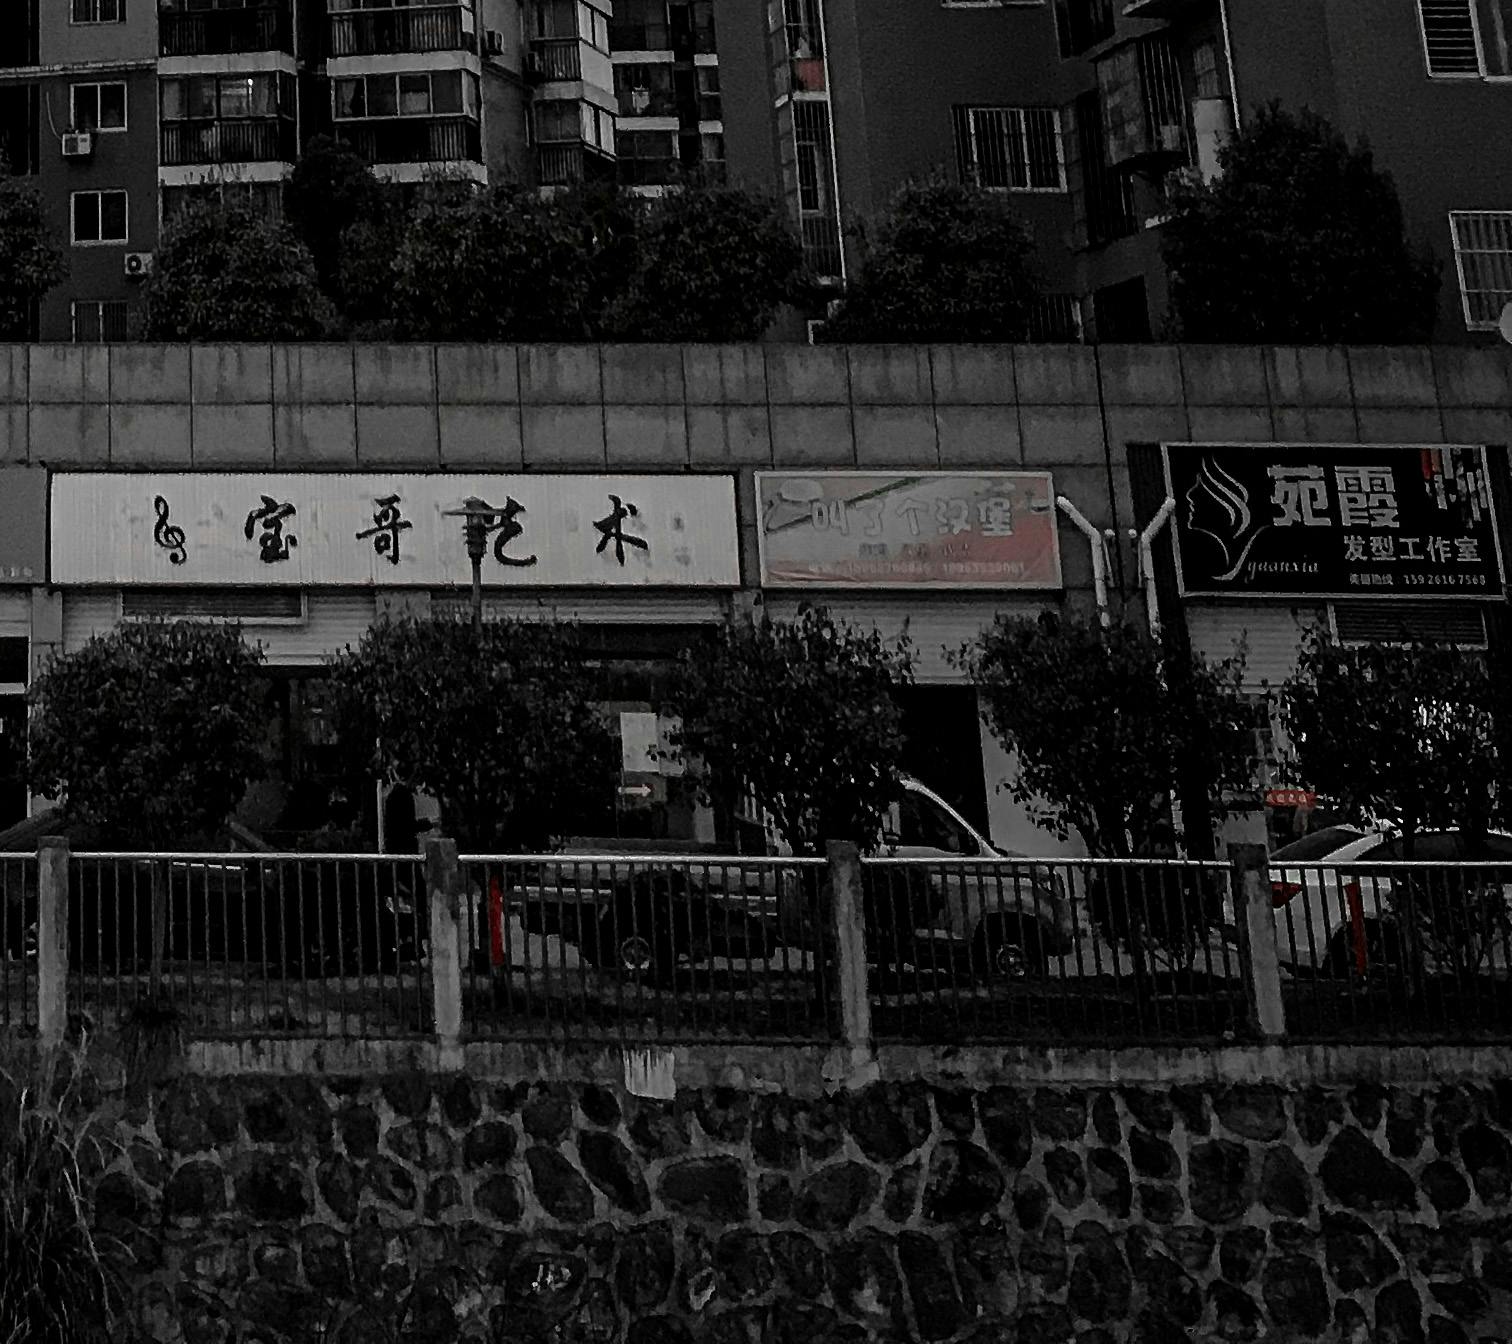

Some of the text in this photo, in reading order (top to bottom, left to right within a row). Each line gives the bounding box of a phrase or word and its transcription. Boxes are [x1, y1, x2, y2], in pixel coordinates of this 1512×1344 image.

[1343, 535, 1482, 563] 发型工作室
